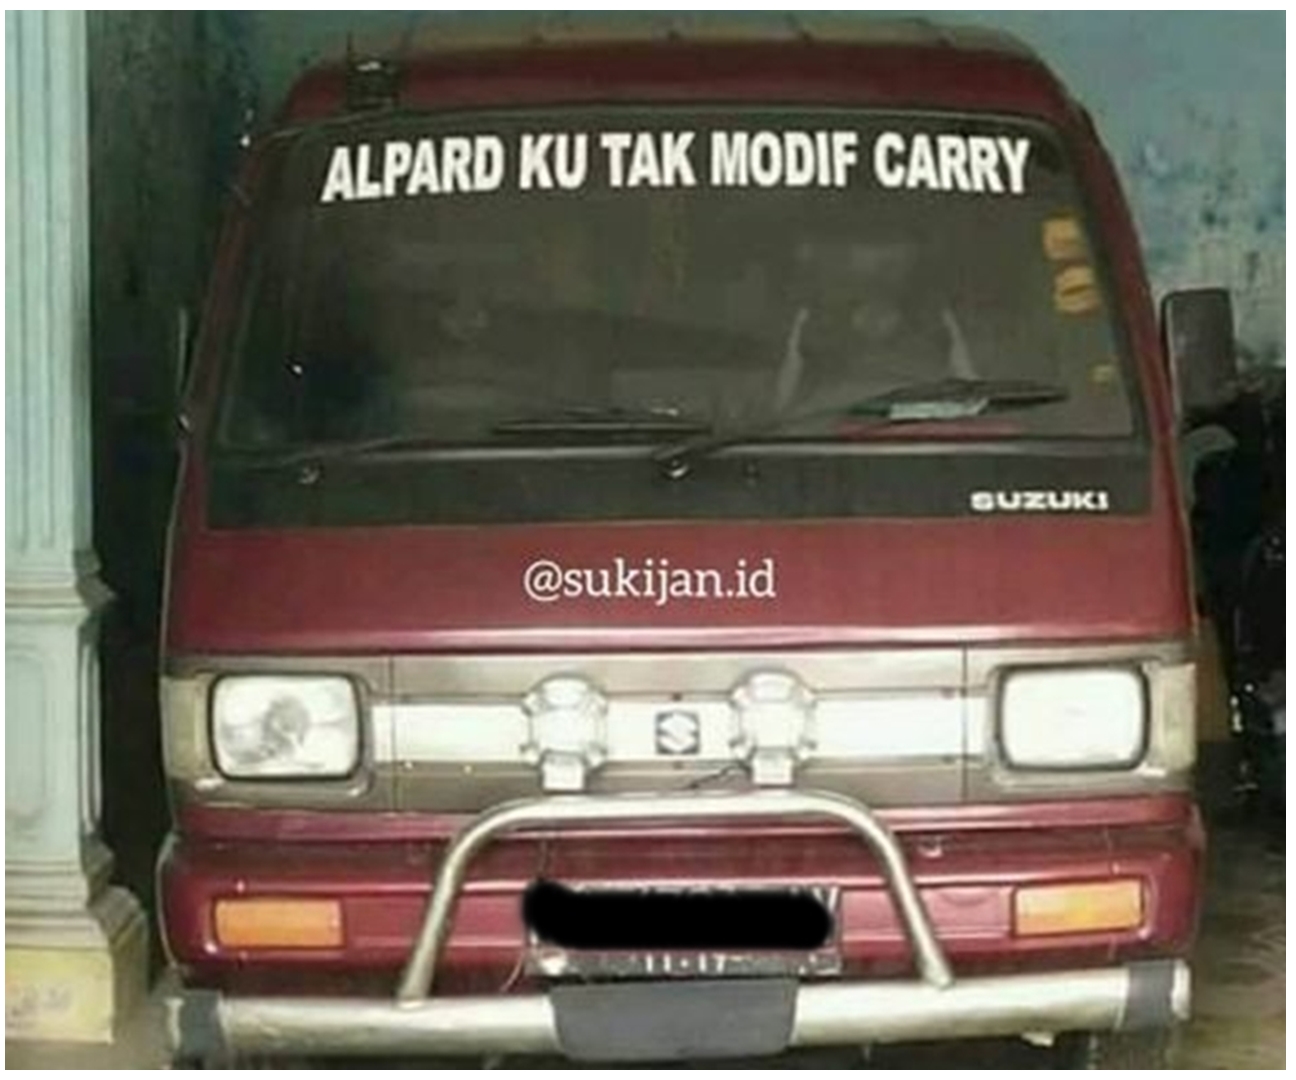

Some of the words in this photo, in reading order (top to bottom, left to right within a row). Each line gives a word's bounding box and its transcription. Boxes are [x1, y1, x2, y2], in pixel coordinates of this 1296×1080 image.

[321, 134, 505, 202] ALPARD
[519, 133, 588, 190] KU
[600, 131, 697, 188] TAK
[710, 131, 858, 188] MODIF
[874, 132, 1031, 194] CARRY
[969, 491, 1109, 511] SUZUKI
